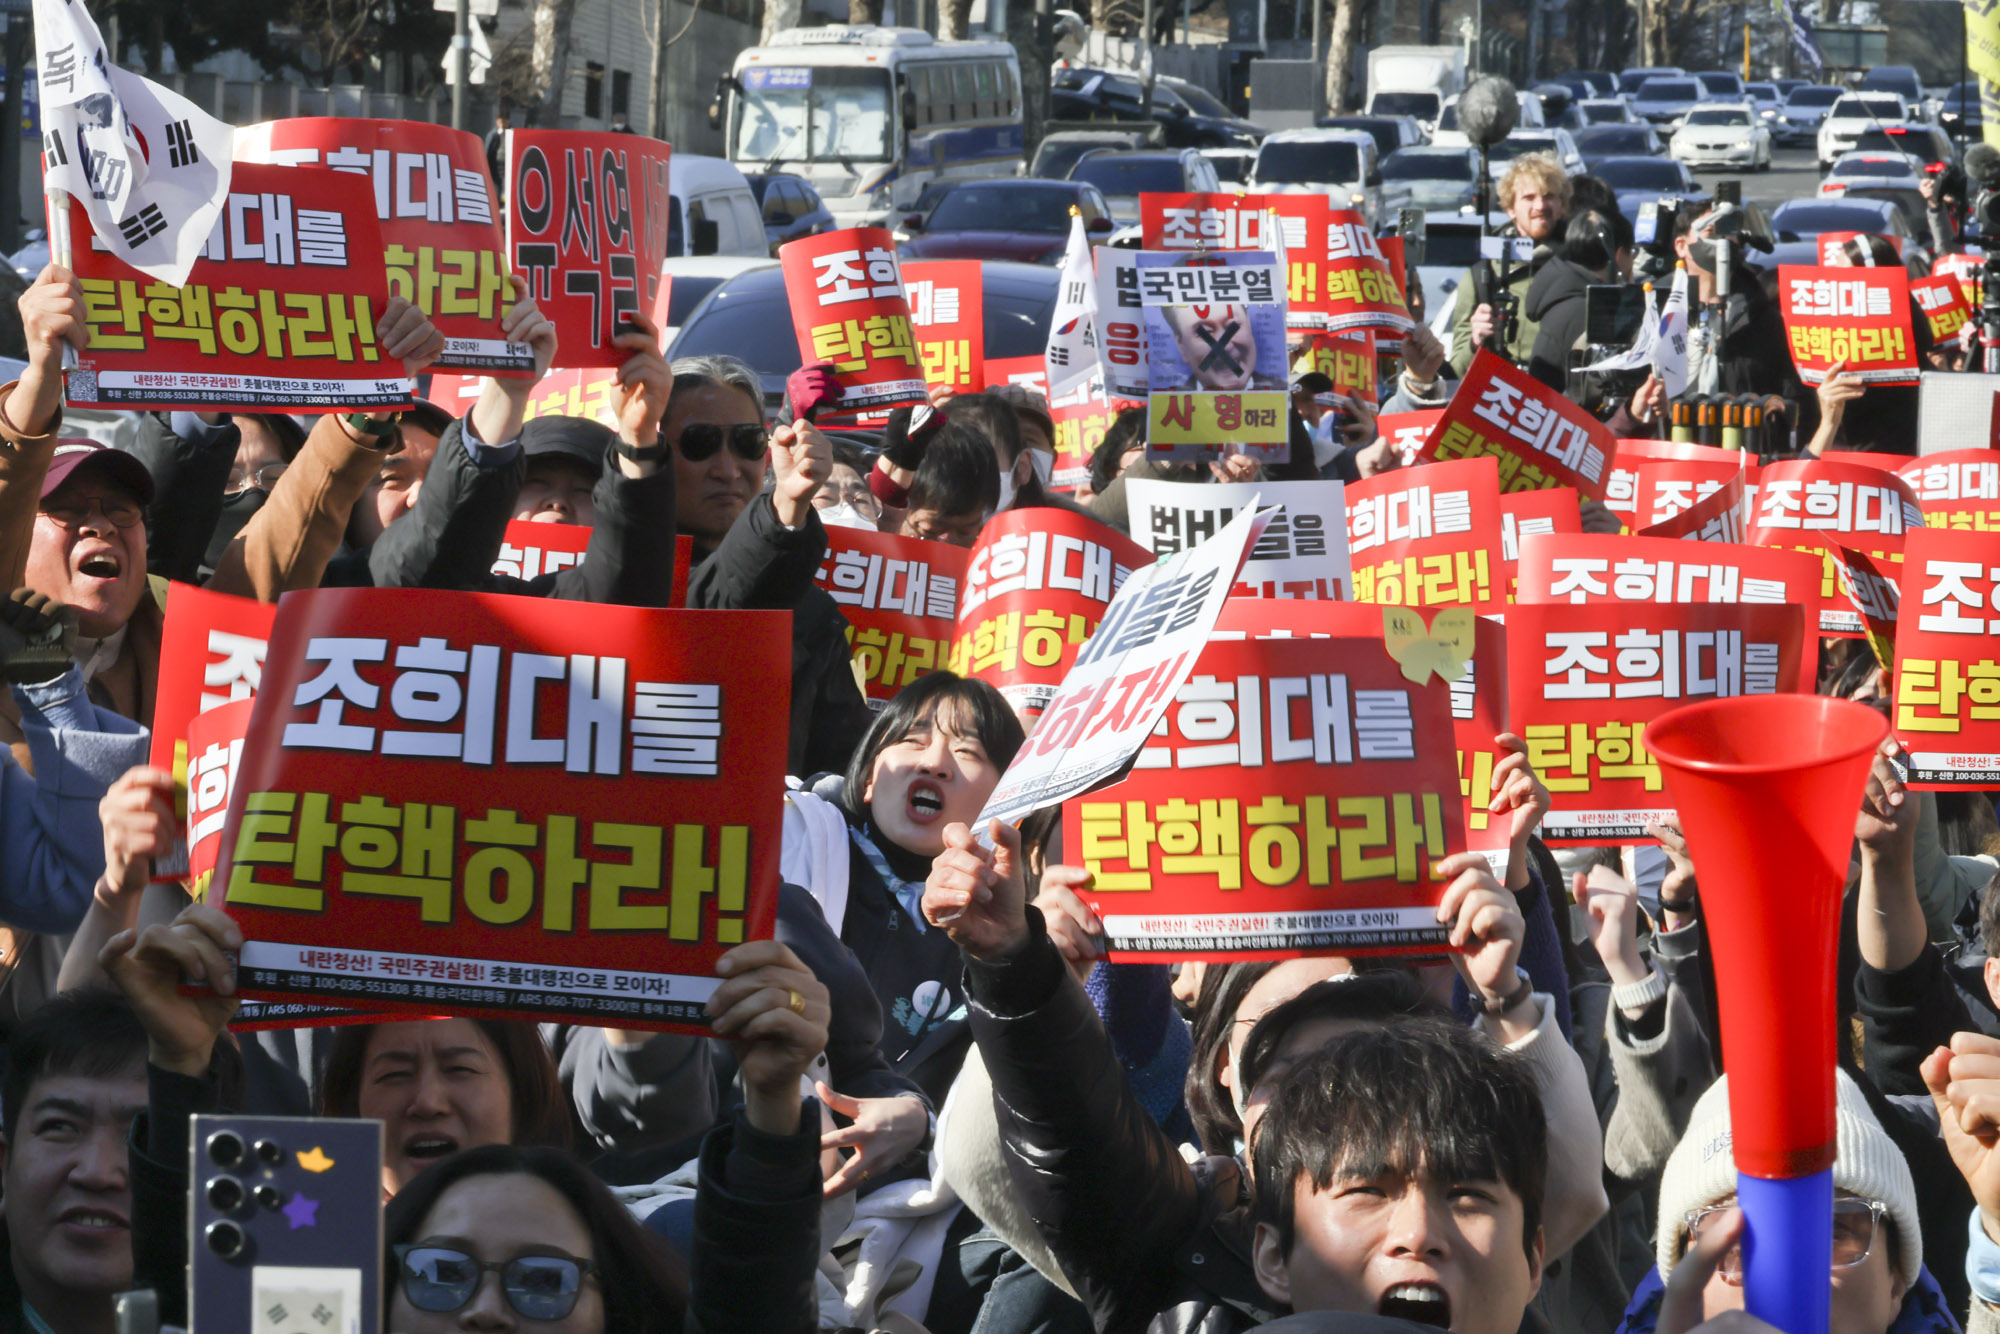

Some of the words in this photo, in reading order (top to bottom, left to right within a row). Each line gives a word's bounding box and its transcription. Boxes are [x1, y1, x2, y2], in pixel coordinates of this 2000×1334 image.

[1143, 268, 1274, 303] 국민분열
[1790, 279, 1892, 317] 조희대를
[79, 278, 380, 362] 탄핵하라!
[917, 340, 971, 385] 라!
[1790, 326, 1906, 363] 탄핵하라!
[106, 390, 122, 399] 후원
[128, 391, 142, 400] 신한
[143, 391, 200, 400] 100-036-551308
[261, 394, 276, 402] ARS
[133, 374, 178, 387] 내란청산!
[180, 375, 241, 388] 국민주권실현!
[243, 378, 311, 391] 촛불대행진으로
[312, 382, 346, 393] 모이자!
[1472, 375, 1605, 485] 조희대를
[1346, 485, 1471, 555] 희대를
[1918, 560, 2000, 635] 조
[1543, 628, 1779, 700] 조희대를
[281, 637, 722, 775] 조희대를
[1917, 771, 1933, 780] 후원
[1938, 771, 1953, 781] 신한
[1955, 772, 2000, 781] 100-036-551
[1946, 756, 1991, 768] 내란청산!
[1577, 812, 1619, 824] 내란청산!
[1586, 827, 1641, 837] 100-036-551308
[1081, 793, 1447, 891] 탄핵하라!
[225, 792, 749, 943] 탄핵하라!
[1140, 919, 1188, 933] 내란청산!
[1191, 917, 1269, 933] 국민주권실현!
[1273, 912, 1357, 931] 촛불대행진으로
[1361, 912, 1400, 928] 모이자!
[299, 950, 372, 972] 내란청산!
[378, 957, 485, 981] 국민주권실현!
[490, 965, 608, 991] 촛불대행진으로
[613, 974, 671, 996] 모이자!
[253, 971, 278, 986] 후원
[288, 973, 311, 988] 신한
[314, 975, 410, 995] 100-036-551308
[412, 985, 507, 1004] 촛불승리전환행동
[517, 992, 542, 1007] ARS
[544, 995, 641, 1014] 060-707-3300(한
[666, 1004, 684, 1017] 1만
[267, 1004, 286, 1015] ARS
